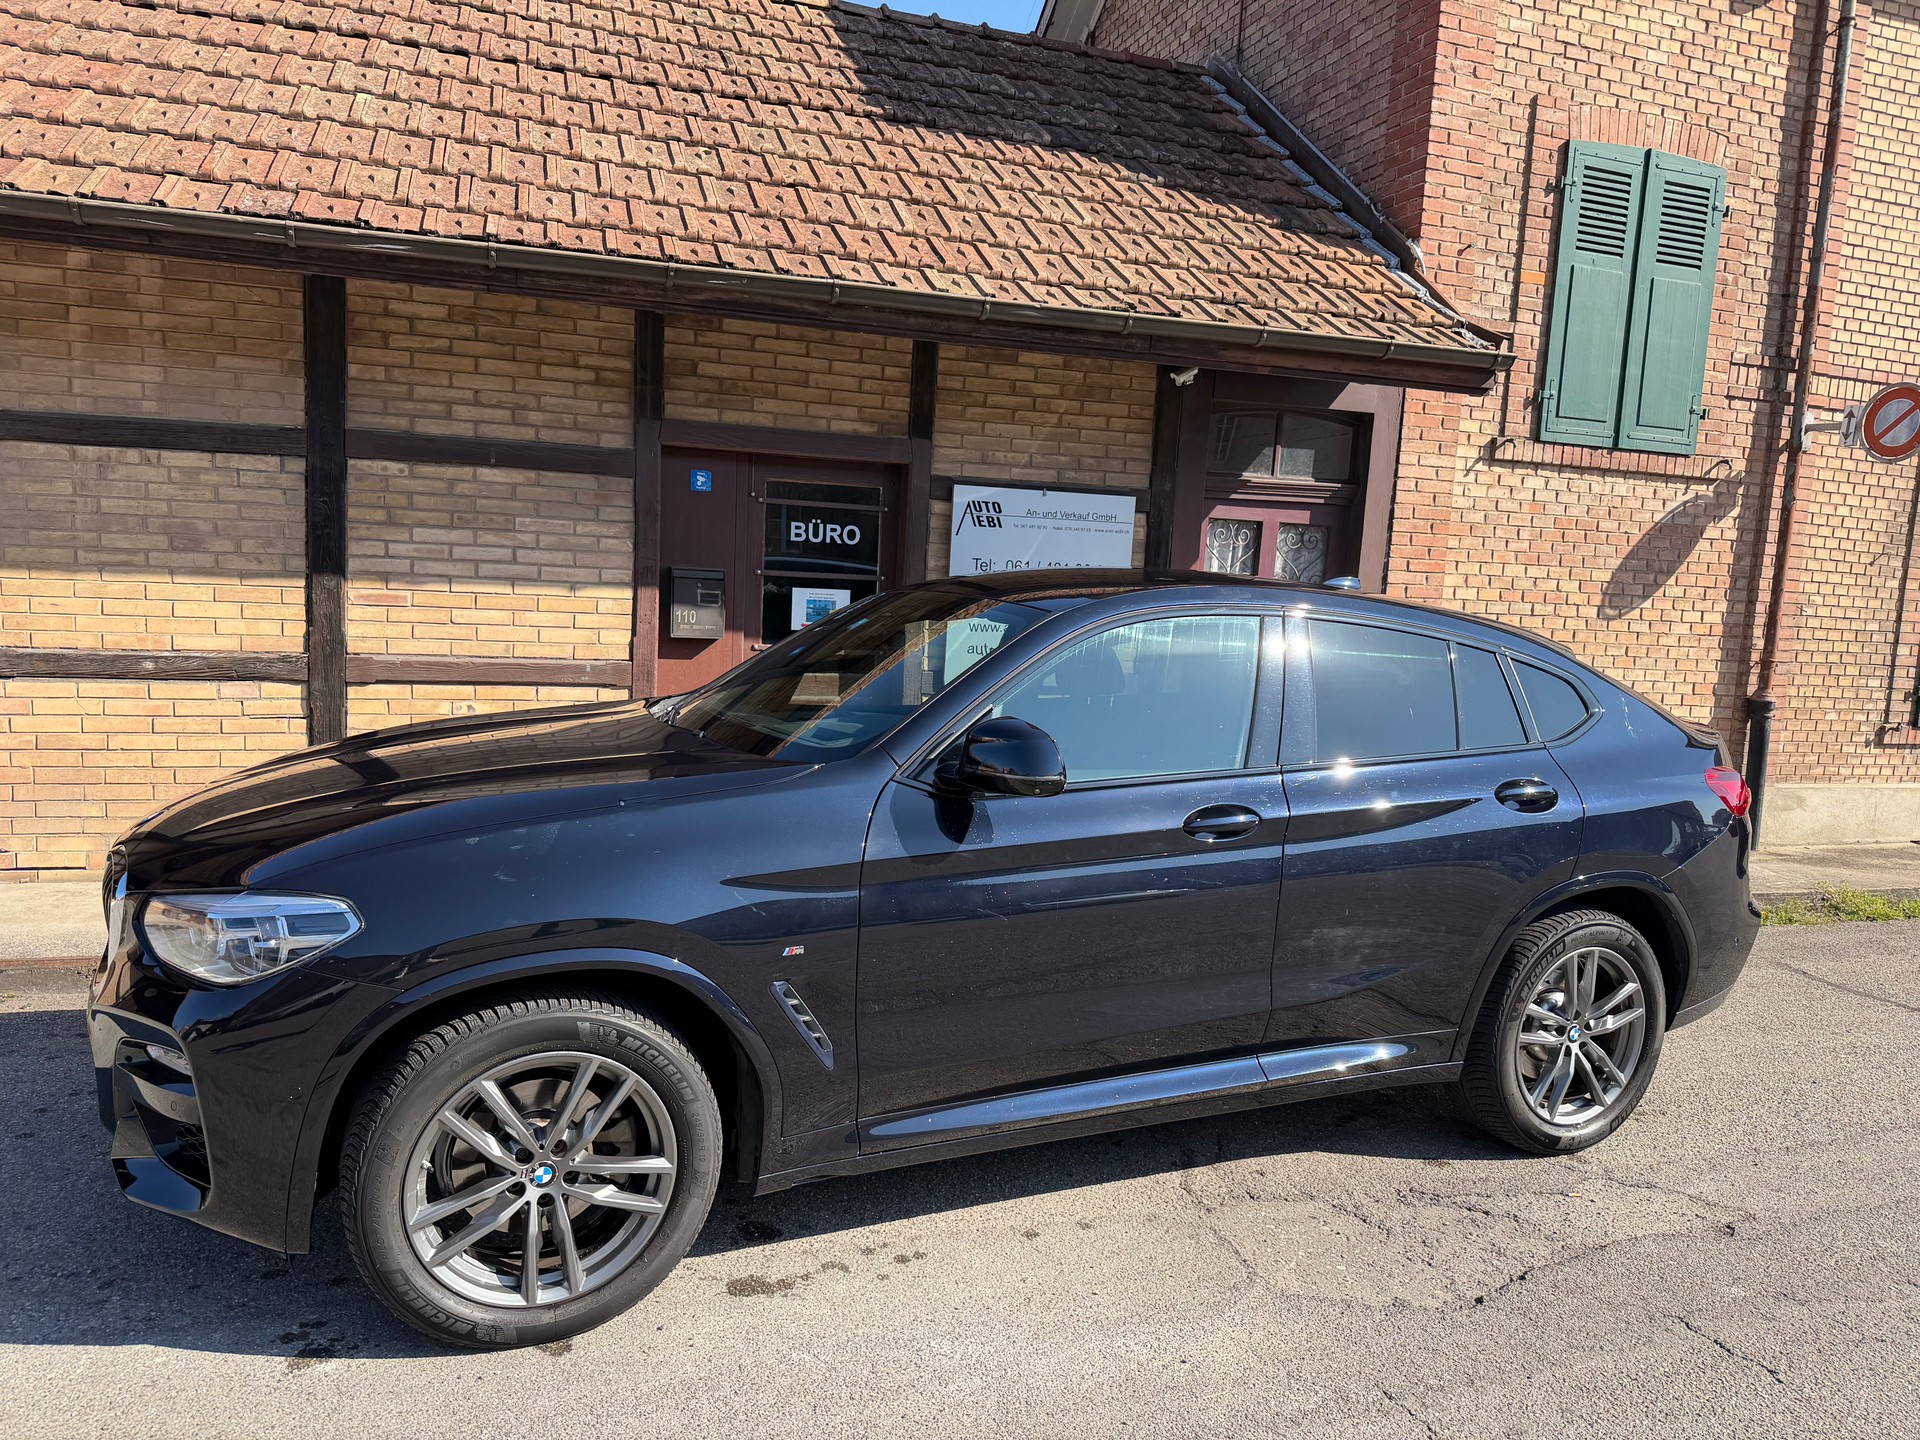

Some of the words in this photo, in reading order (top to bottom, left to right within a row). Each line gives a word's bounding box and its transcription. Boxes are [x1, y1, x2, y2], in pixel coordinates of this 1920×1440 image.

[1026, 508, 1040, 517] An-
[1042, 510, 1057, 519] und
[1060, 511, 1090, 520] Verkauf
[1091, 512, 1117, 522] GmbH
[790, 519, 861, 545] BÜRO
[972, 558, 996, 572] Tel:
[676, 609, 697, 624] 110
[1520, 943, 1564, 1001] MICHELIN
[620, 1036, 697, 1101] MICHELIN
[371, 1192, 382, 1229] ALPIN
[375, 1231, 389, 1261] PILOT
[391, 1273, 474, 1335] MICHELIN
